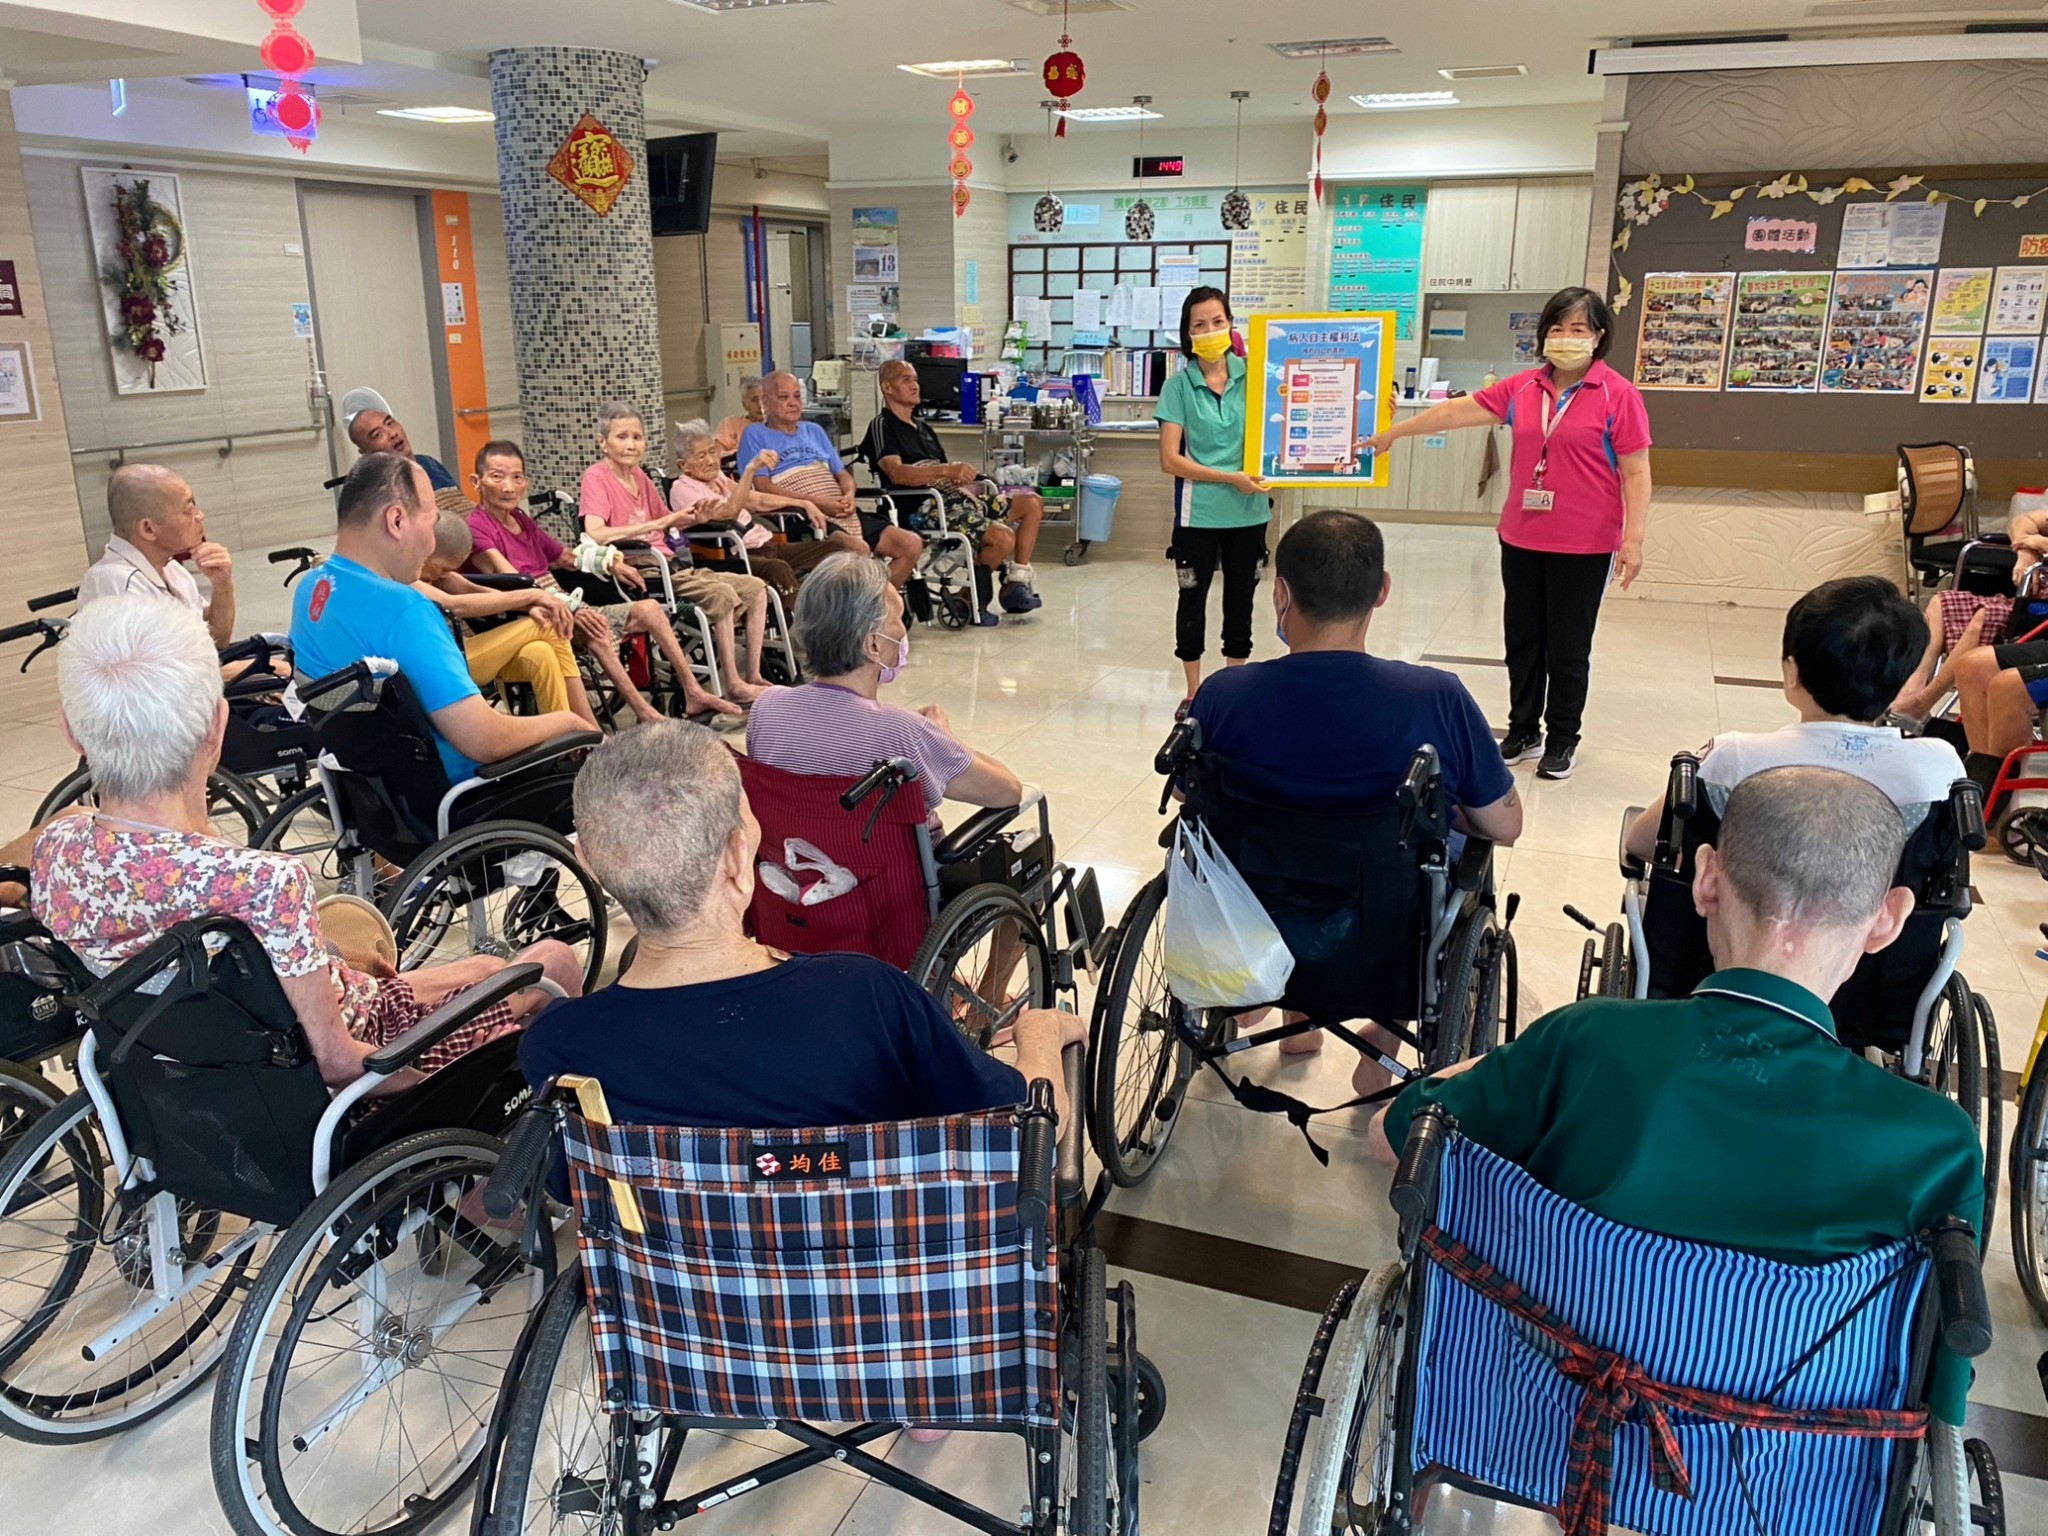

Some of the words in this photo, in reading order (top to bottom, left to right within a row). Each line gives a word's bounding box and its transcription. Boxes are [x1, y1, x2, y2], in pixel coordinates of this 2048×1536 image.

[1158, 161, 1182, 171] 1449
[1275, 200, 1308, 215] 住民
[1380, 193, 1416, 209] 住民
[1752, 228, 1810, 243] 團體活動
[451, 235, 460, 271] 110
[881, 254, 896, 272] 13
[1288, 331, 1361, 343] 病人自主權利法
[789, 1151, 843, 1174] 均佳
